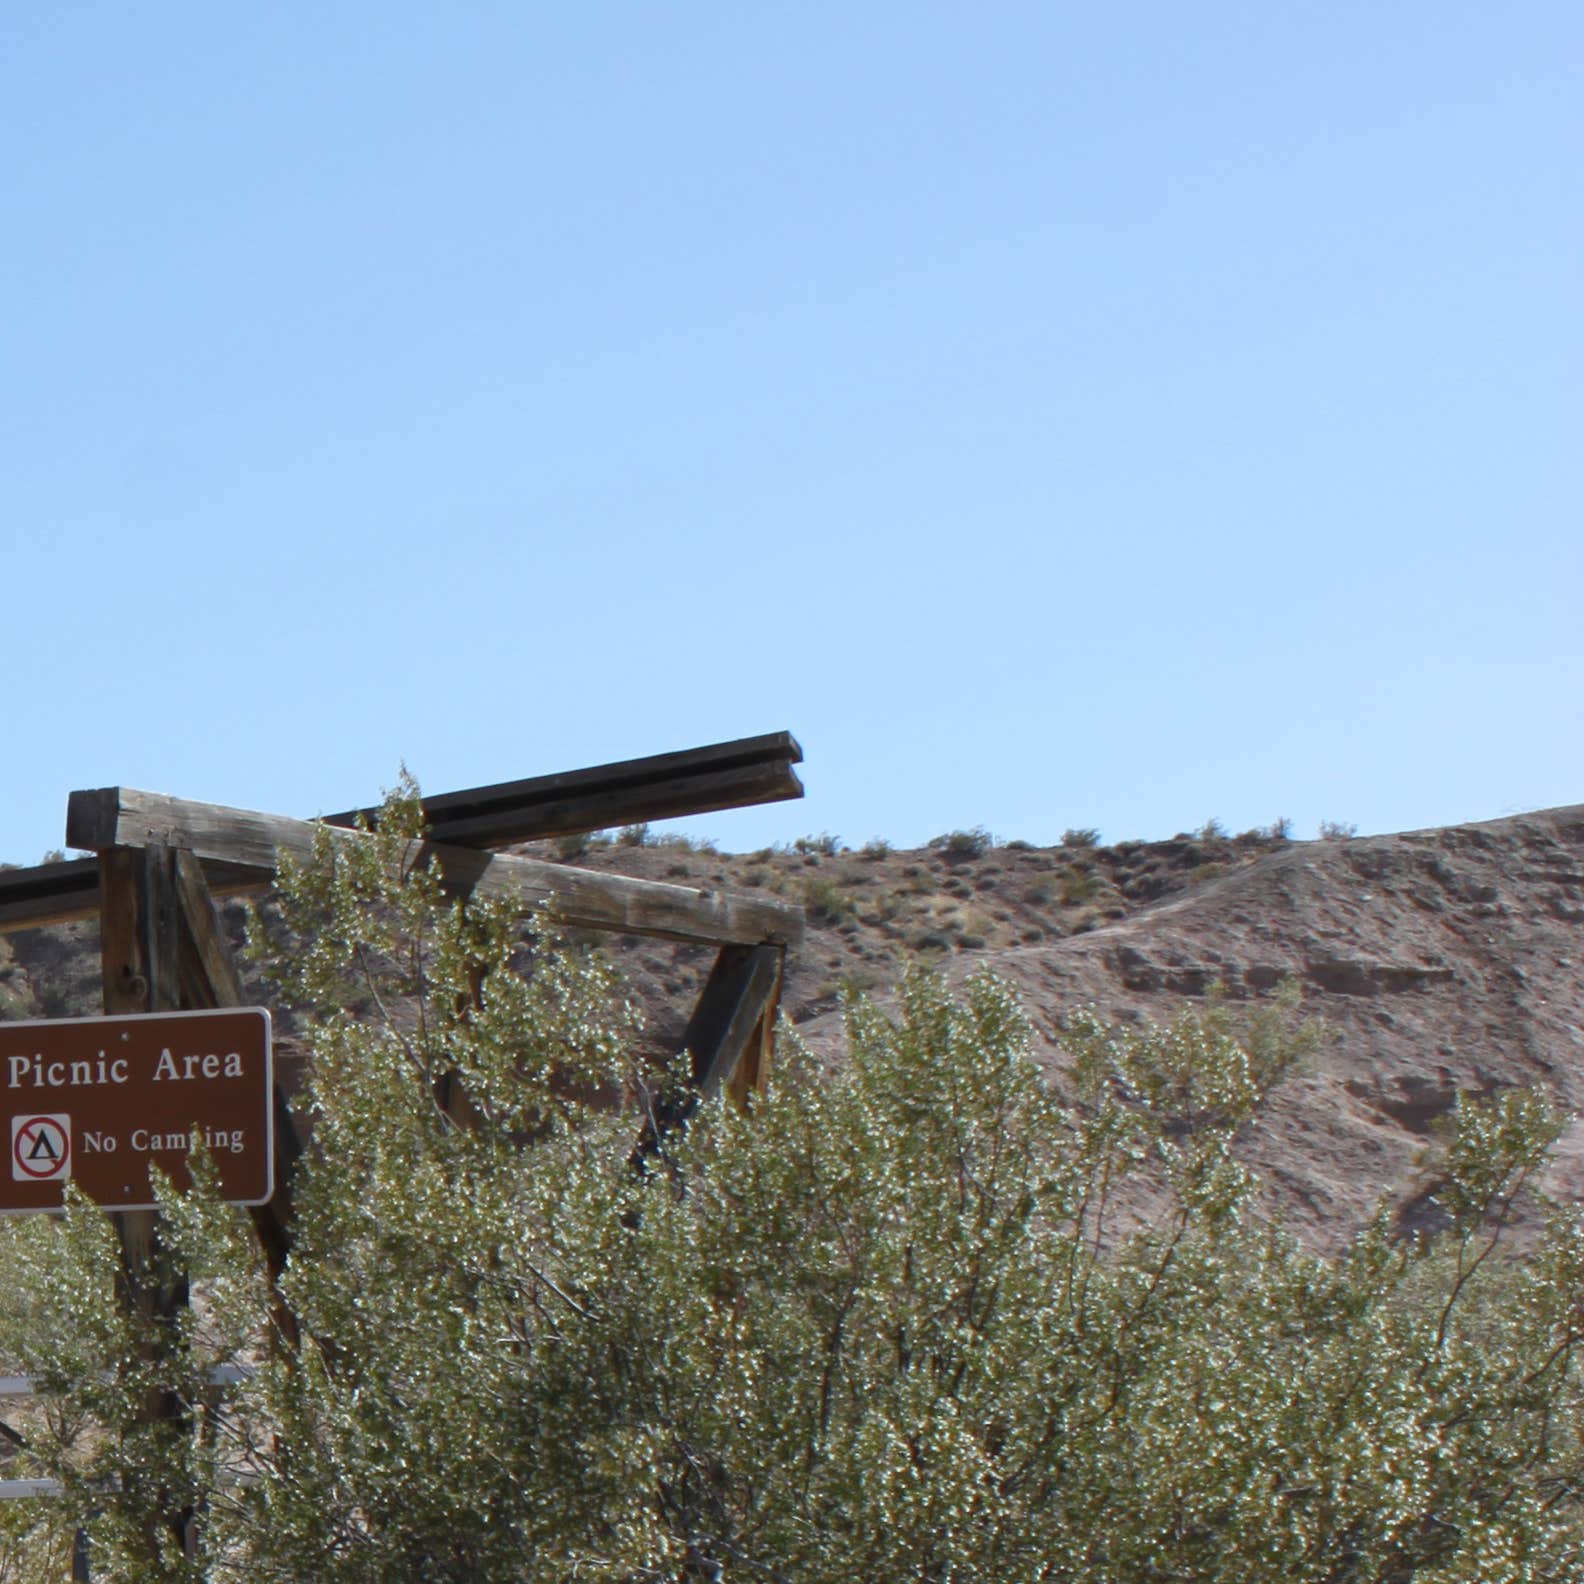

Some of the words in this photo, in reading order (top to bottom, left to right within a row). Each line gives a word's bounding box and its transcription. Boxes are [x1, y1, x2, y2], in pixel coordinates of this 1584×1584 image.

[7, 1049, 129, 1089] Picnic
[152, 1047, 245, 1081] Area
[82, 1131, 117, 1153] No
[131, 1125, 245, 1154] Caming
